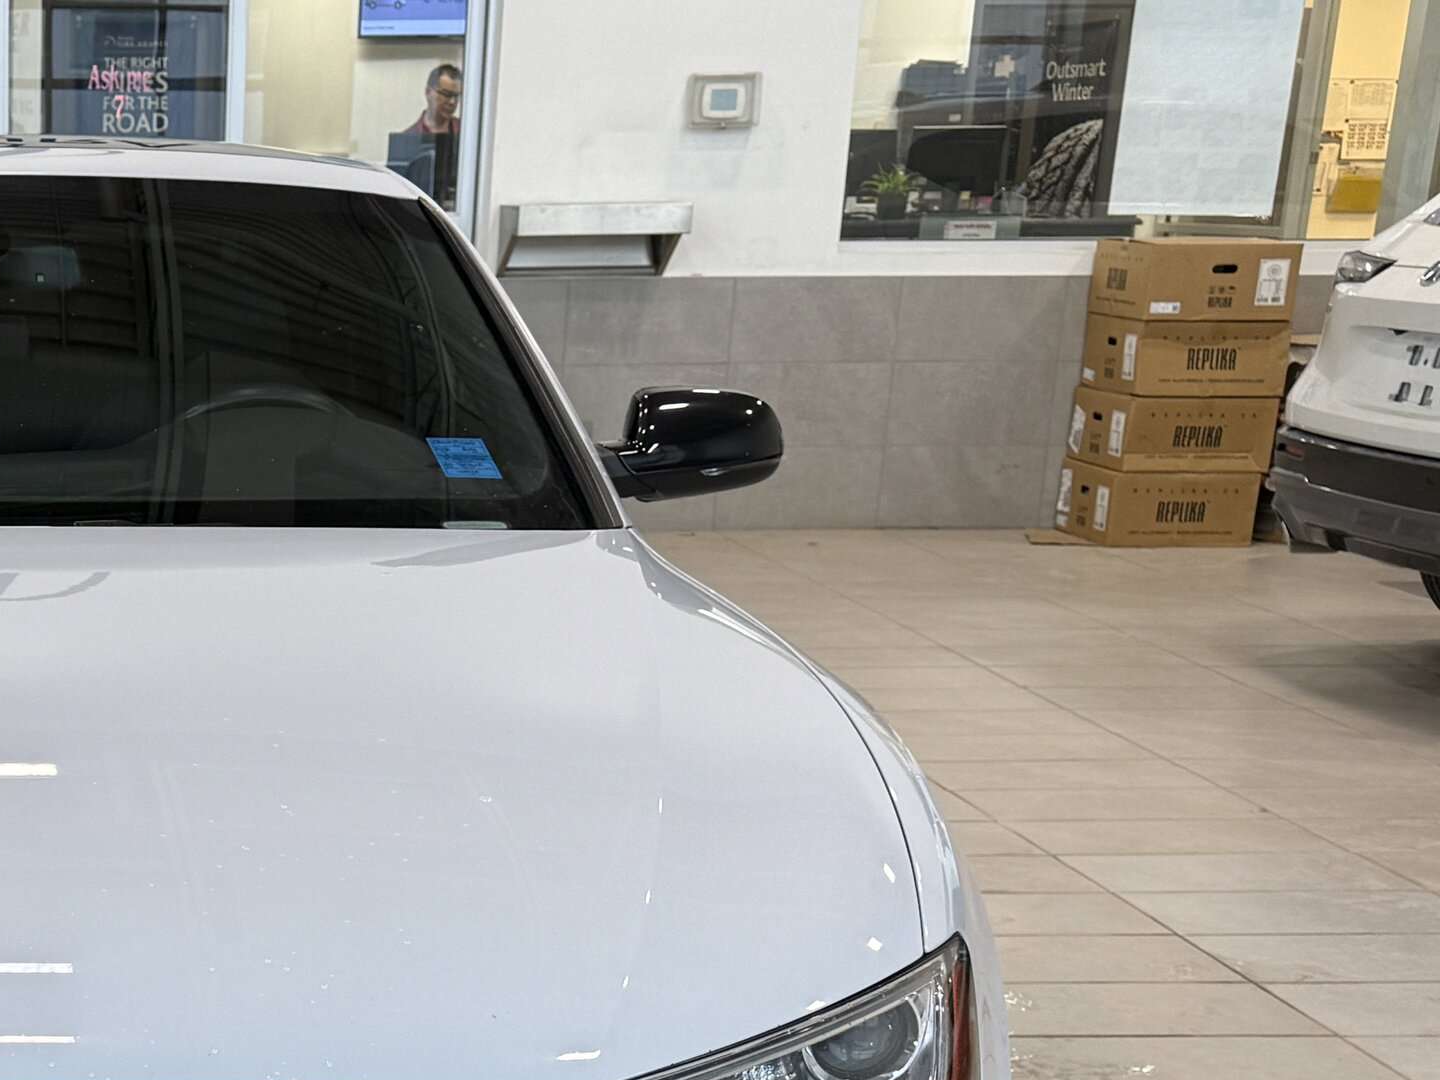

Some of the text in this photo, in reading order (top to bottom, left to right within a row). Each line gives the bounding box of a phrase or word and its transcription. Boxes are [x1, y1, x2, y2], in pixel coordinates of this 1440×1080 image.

[104, 56, 168, 69] THE RIGHT
[1046, 58, 1106, 79] Outsmart
[1052, 83, 1094, 102] Winter
[137, 96, 168, 110] THE
[102, 113, 169, 132] ROAD
[1186, 347, 1238, 370] REPLIKA
[1172, 425, 1223, 448] REPLIKA
[1156, 501, 1206, 523] REPLIKA
